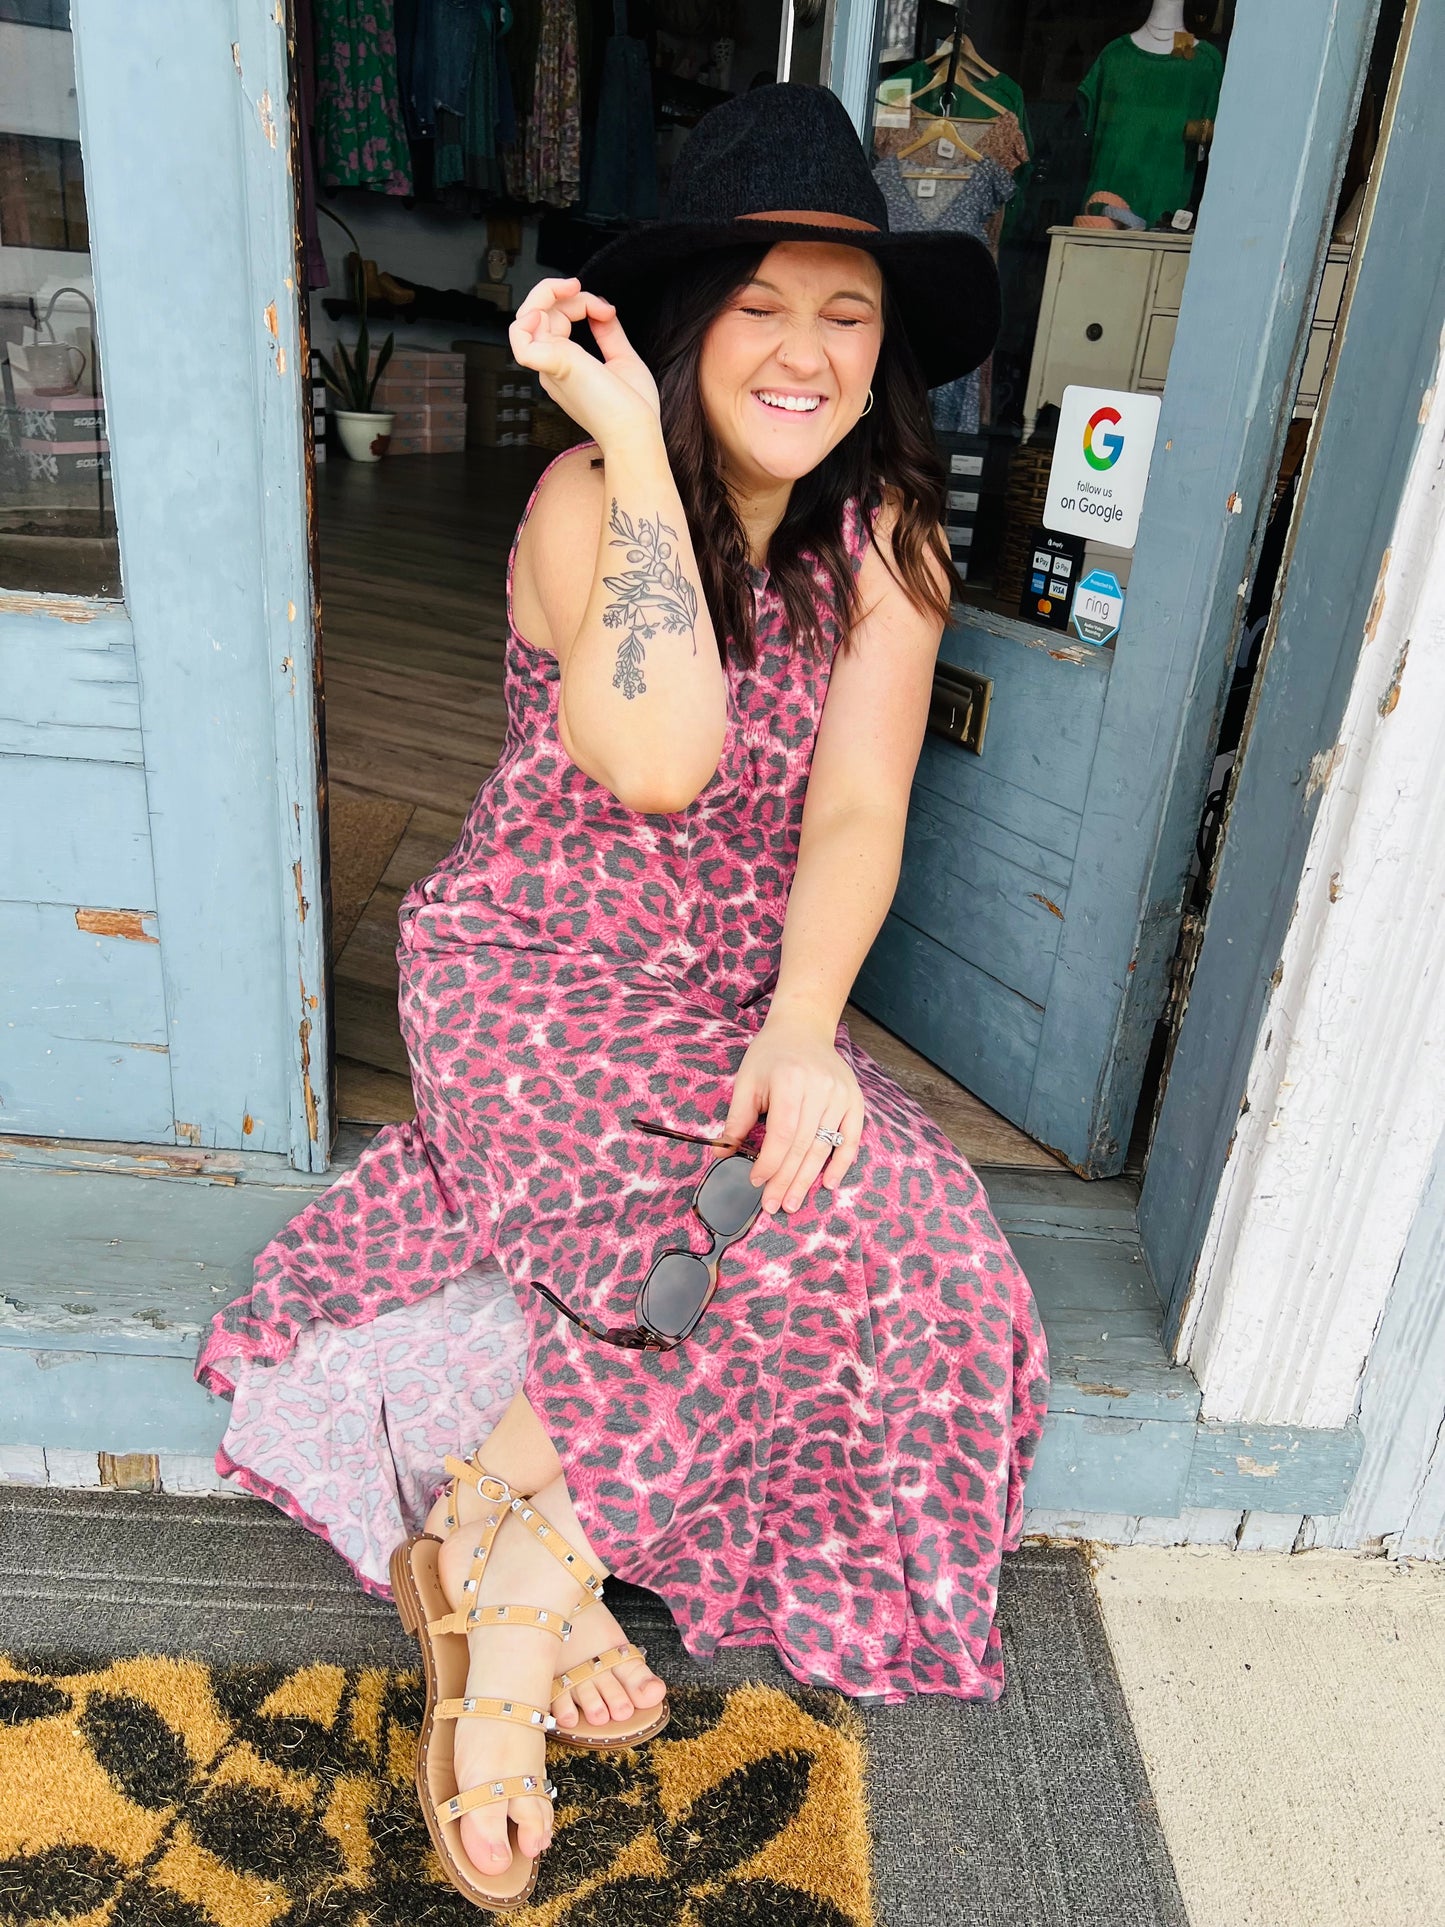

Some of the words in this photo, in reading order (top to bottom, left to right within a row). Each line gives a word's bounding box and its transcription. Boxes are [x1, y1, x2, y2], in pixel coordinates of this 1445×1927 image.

[73, 417, 103, 427] SODA
[1077, 480, 1102, 495] follow
[1103, 489, 1113, 498] us
[1061, 497, 1076, 510] on
[1078, 497, 1123, 523] Google
[1039, 557, 1049, 567] Pay
[1061, 563, 1070, 574] Pay
[1052, 585, 1065, 595] VISA
[1086, 595, 1110, 620] ring
